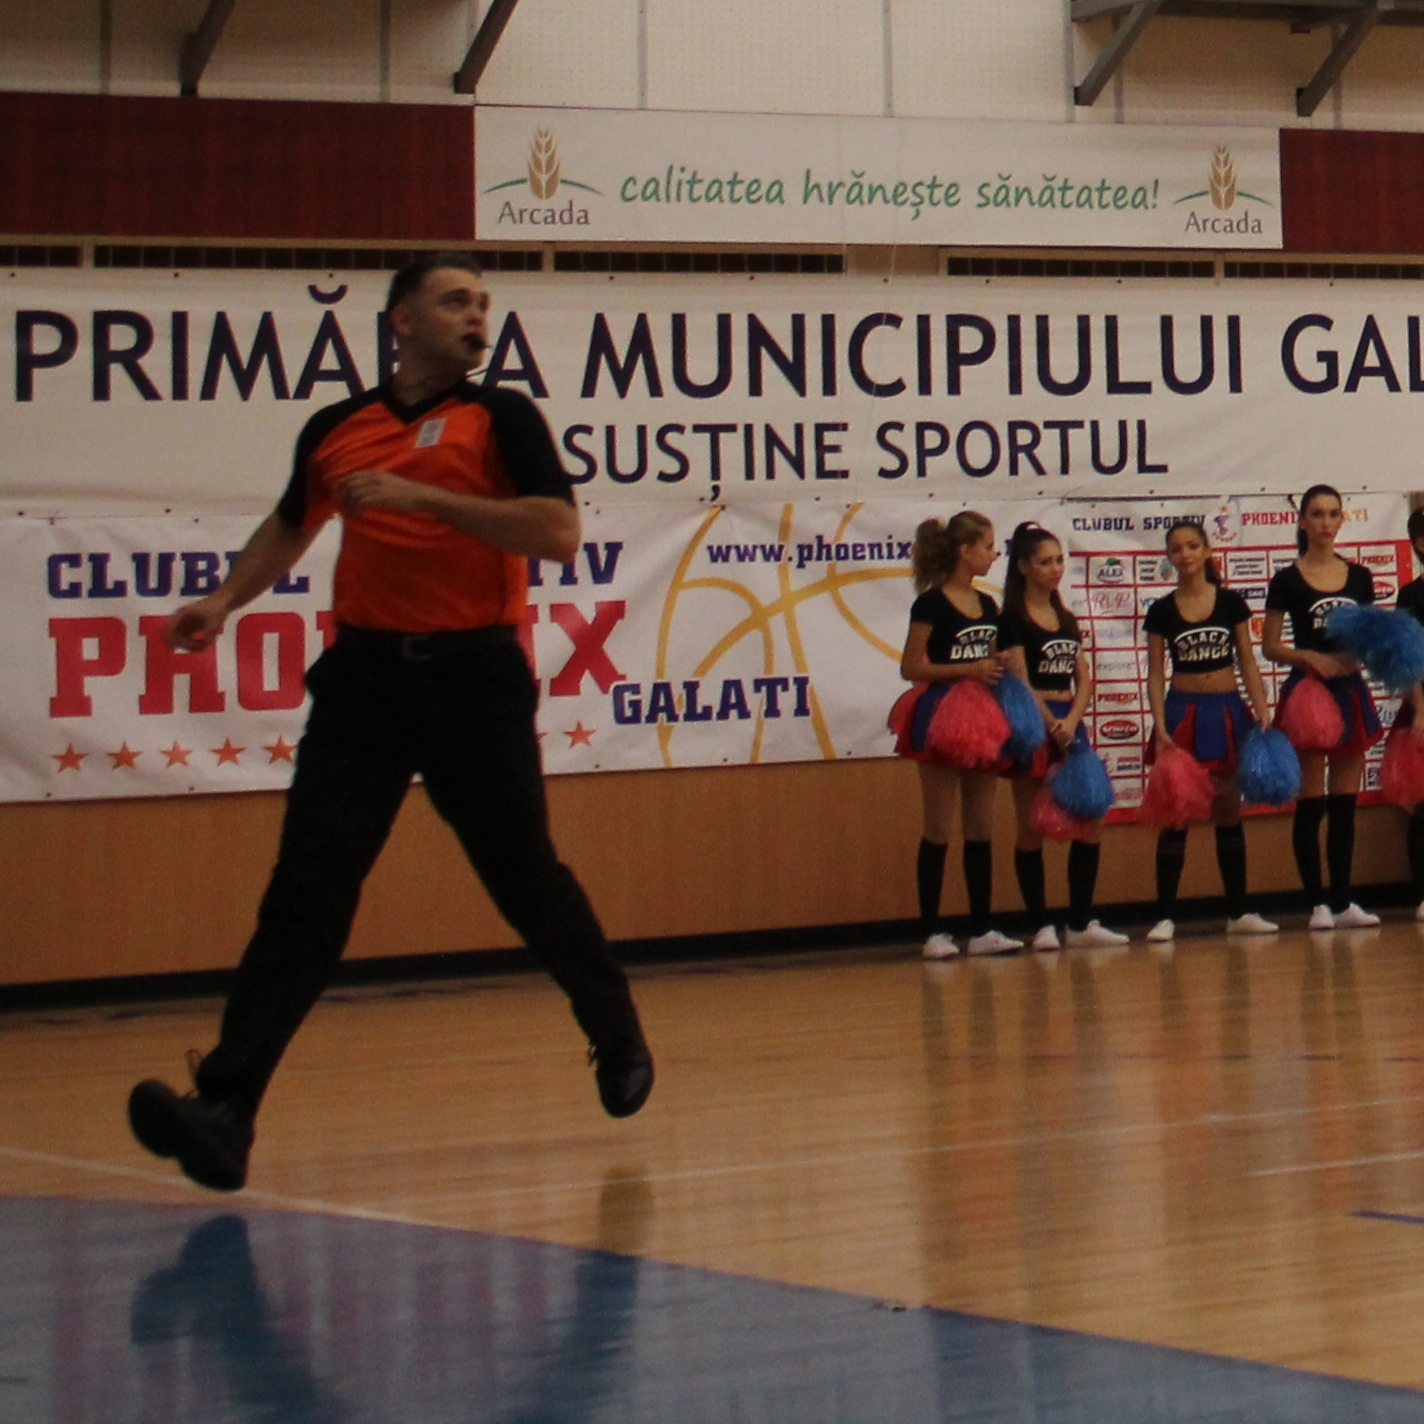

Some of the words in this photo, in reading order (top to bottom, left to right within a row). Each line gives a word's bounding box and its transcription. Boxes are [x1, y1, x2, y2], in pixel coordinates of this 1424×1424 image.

[620, 165, 785, 205] calitatea
[977, 173, 1160, 210] sănătatea!
[498, 201, 590, 226] Arcada
[1184, 211, 1263, 234] Arcada
[580, 312, 1243, 400] MUNICIPIULUI
[876, 419, 1169, 480] SPORTUL
[1073, 517, 1135, 532] CLUBUL
[1241, 511, 1300, 526] PHOENI
[611, 676, 812, 725] GALATI
